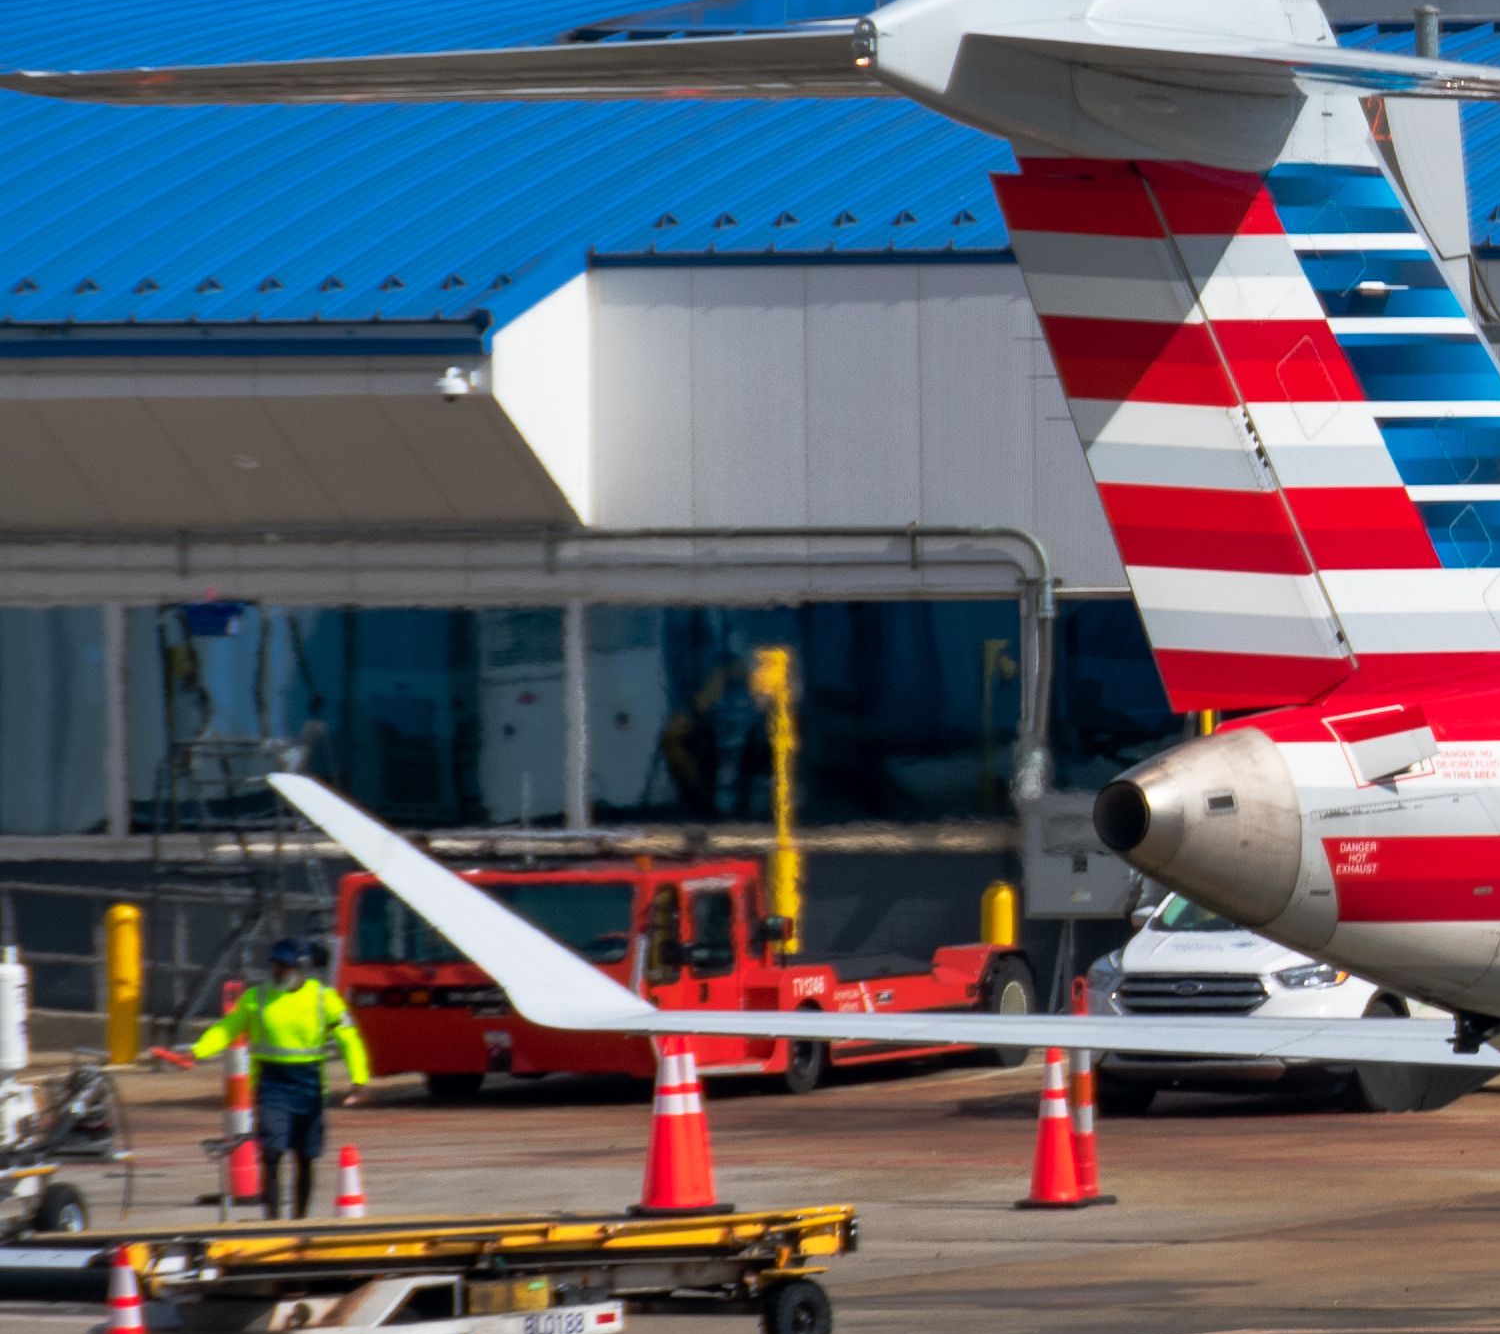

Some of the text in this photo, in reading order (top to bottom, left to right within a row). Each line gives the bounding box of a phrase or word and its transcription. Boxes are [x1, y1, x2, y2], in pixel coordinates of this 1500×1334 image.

[1340, 841, 1377, 853] DANGER
[1349, 853, 1367, 862] HOT
[1336, 863, 1377, 875] EXHAUST
